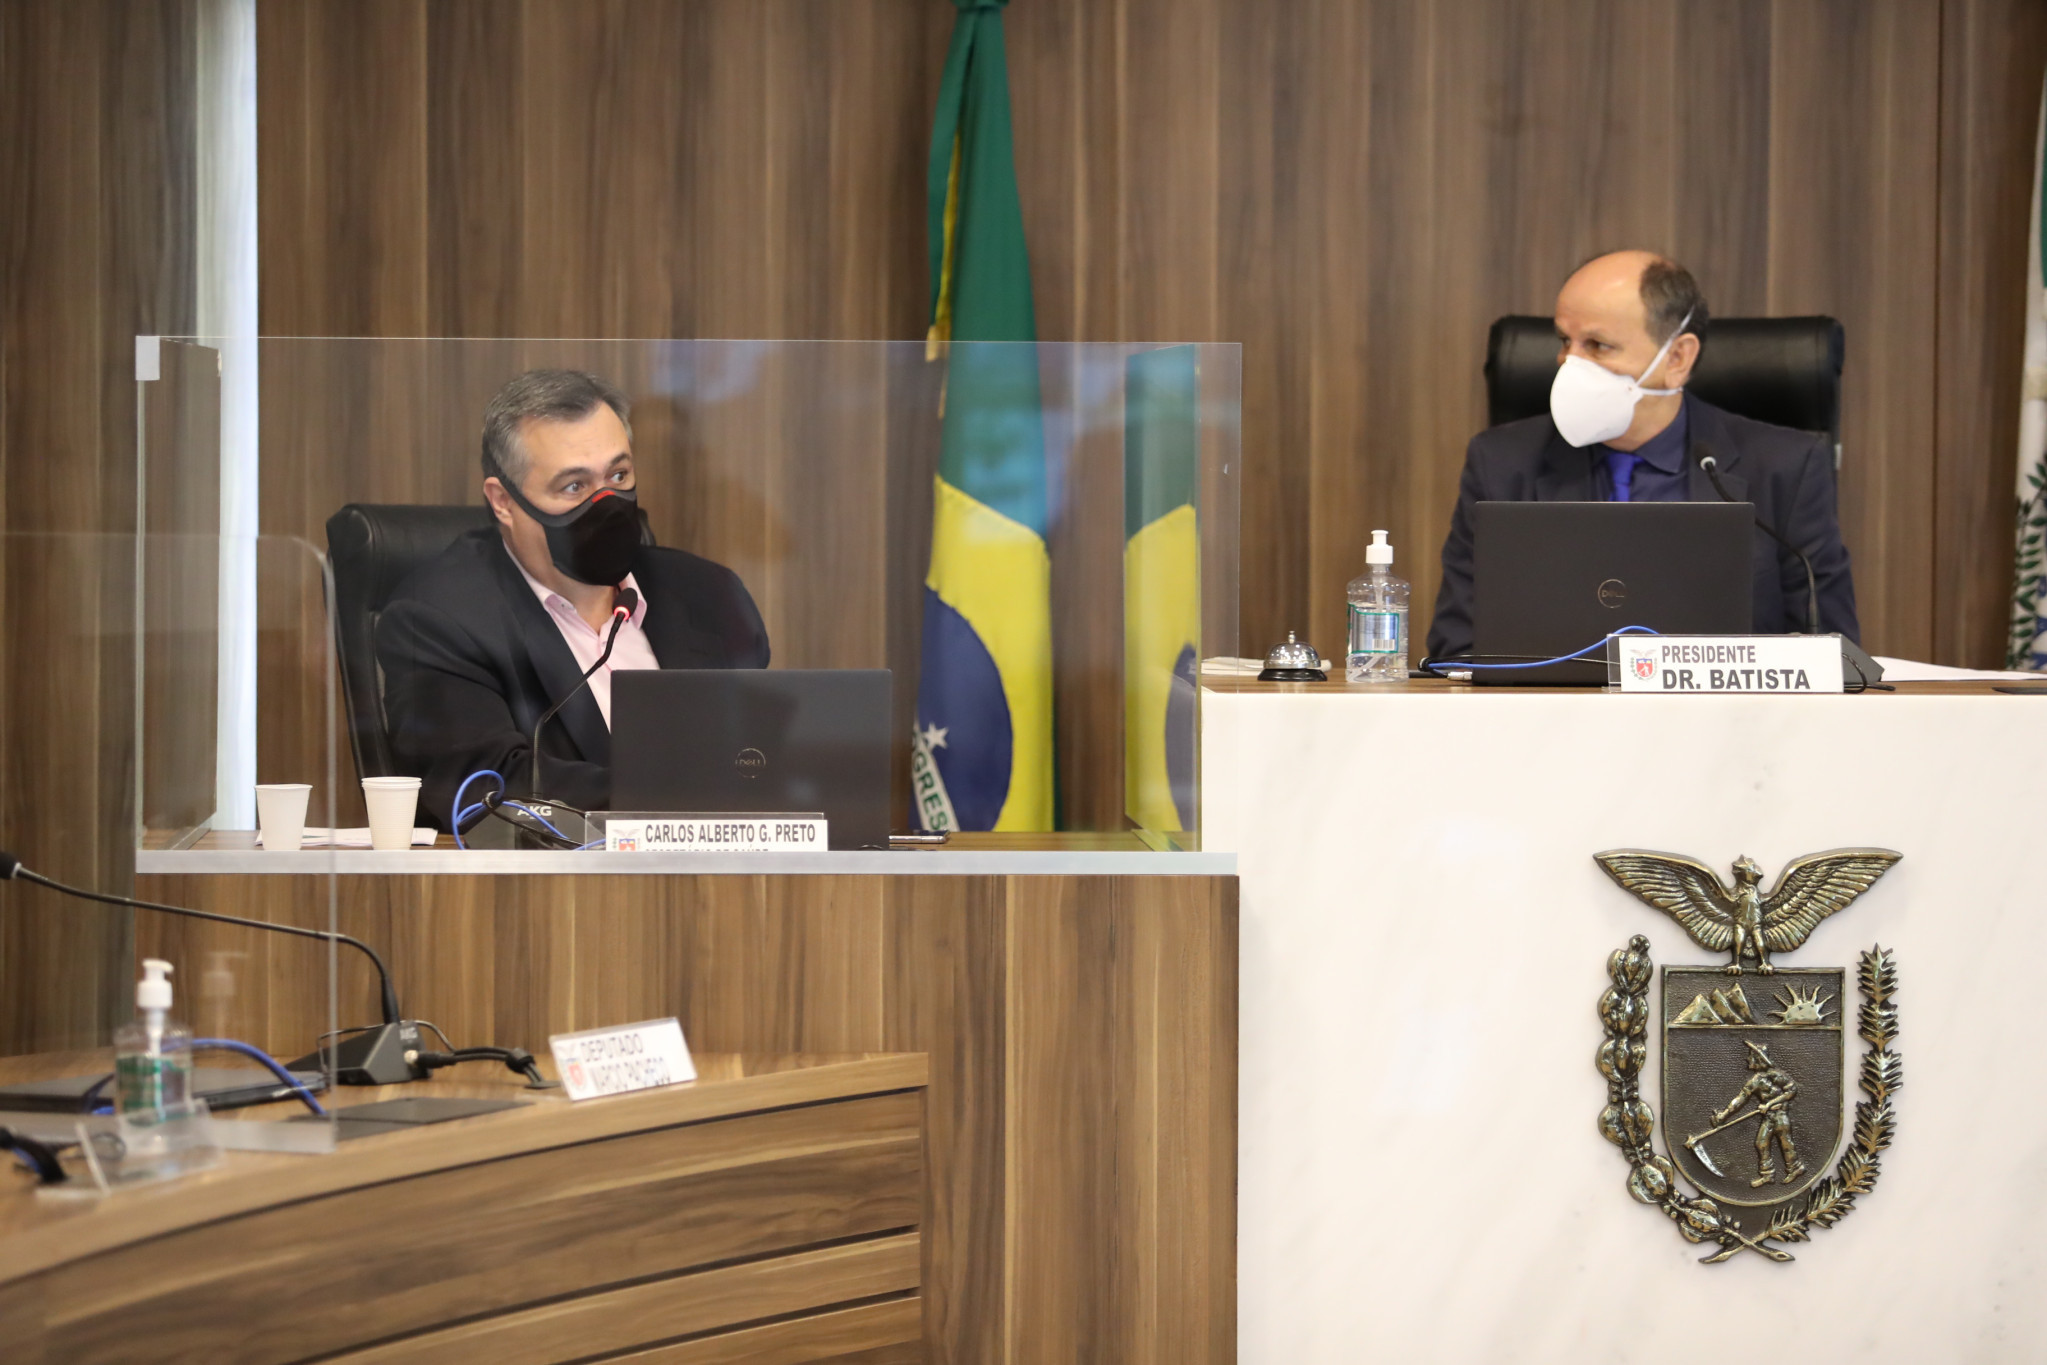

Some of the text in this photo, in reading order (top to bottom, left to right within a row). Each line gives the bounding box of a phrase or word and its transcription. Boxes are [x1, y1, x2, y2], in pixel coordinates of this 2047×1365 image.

[1661, 645, 1756, 664] PRESIDENTE
[1662, 669, 1811, 690] DR. BATISTA
[517, 805, 552, 817] AKG
[645, 824, 816, 843] CARLOS ALBERTO G. PRETO
[580, 1033, 644, 1063] DEPUTADO
